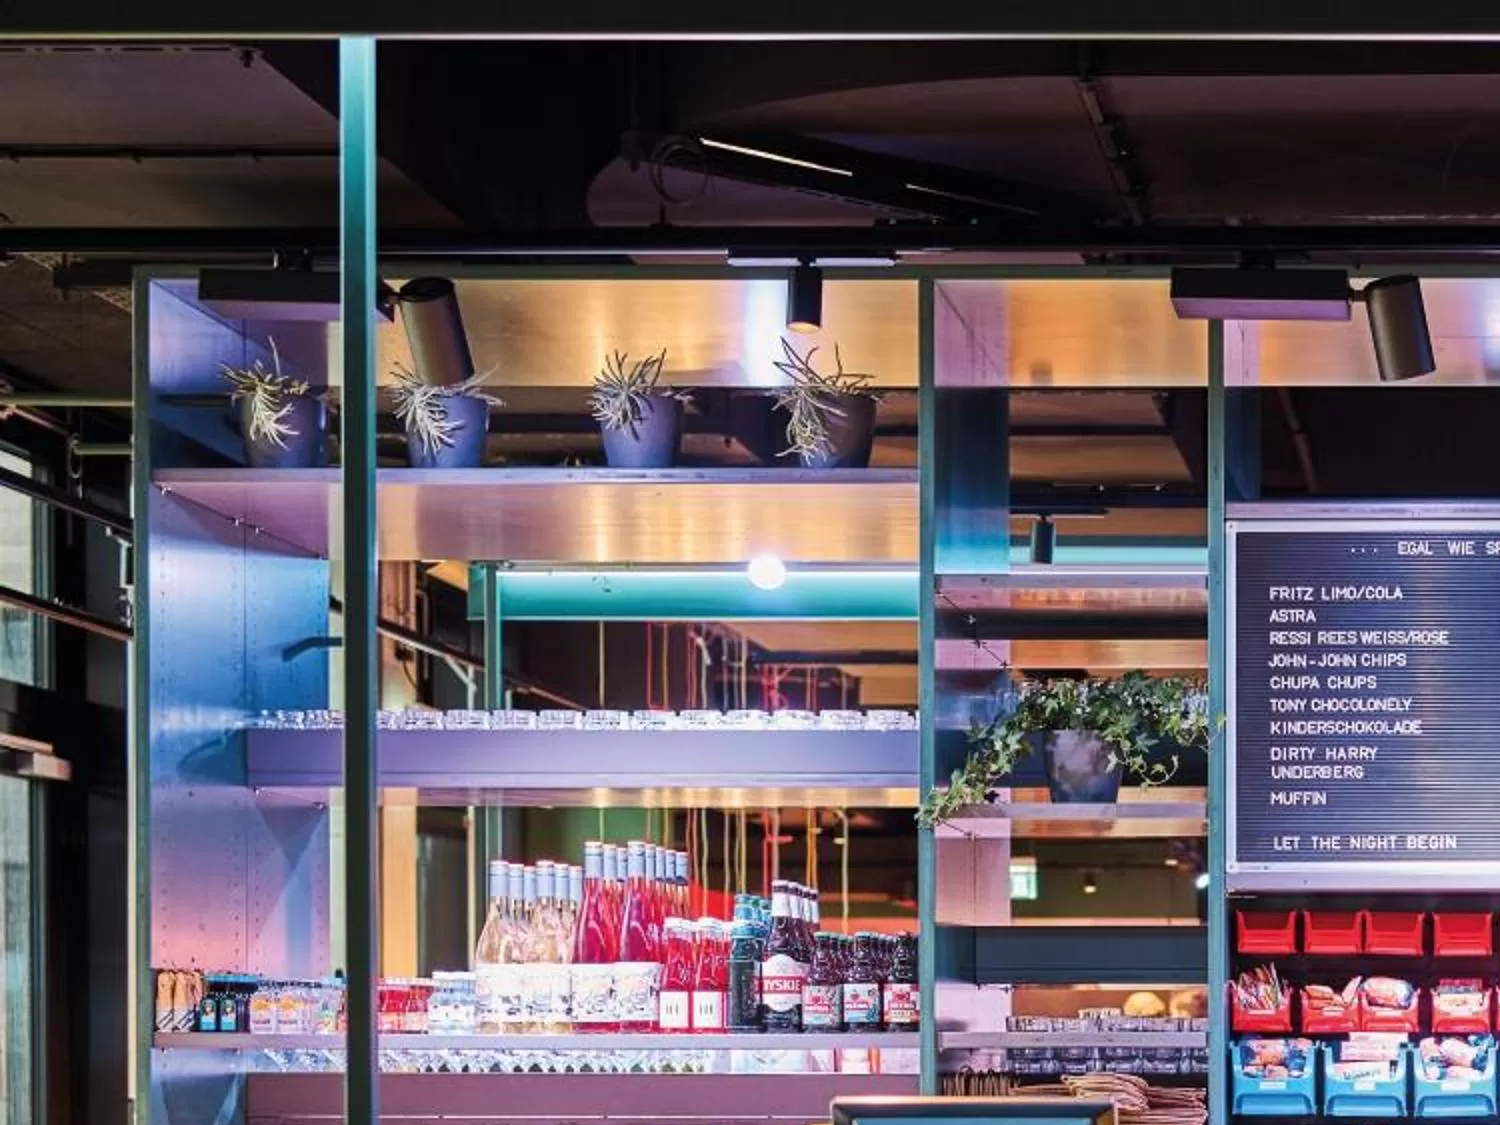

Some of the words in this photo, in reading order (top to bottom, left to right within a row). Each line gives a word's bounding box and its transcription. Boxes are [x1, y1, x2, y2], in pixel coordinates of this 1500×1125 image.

[1397, 540, 1434, 556] EGAL
[1447, 540, 1476, 556] WIE
[1268, 586, 1315, 601] FRITZ
[1320, 585, 1404, 601] LIMO/COLA
[1268, 609, 1317, 624] ASTRA
[1268, 630, 1312, 646] RESSI
[1317, 630, 1357, 646] REES
[1360, 630, 1450, 646] WEISS/ROSE
[1361, 653, 1407, 668] CHIPS
[1269, 675, 1320, 690] CHUPA
[1327, 675, 1378, 690] CHUPS
[1269, 697, 1308, 713] TONY
[1310, 697, 1413, 713] CHOCOLONELY
[1269, 719, 1423, 735] KINDERSCHOKOLADE
[1269, 746, 1316, 761] DIRTY
[1325, 745, 1378, 761] HARRY
[1270, 764, 1365, 780] UNDERBERG
[1269, 791, 1327, 806] MUFFIN
[1273, 836, 1301, 851] LET
[1311, 836, 1341, 850] THE
[1349, 835, 1397, 850] NIGHT
[1406, 834, 1458, 850] BEGIN
